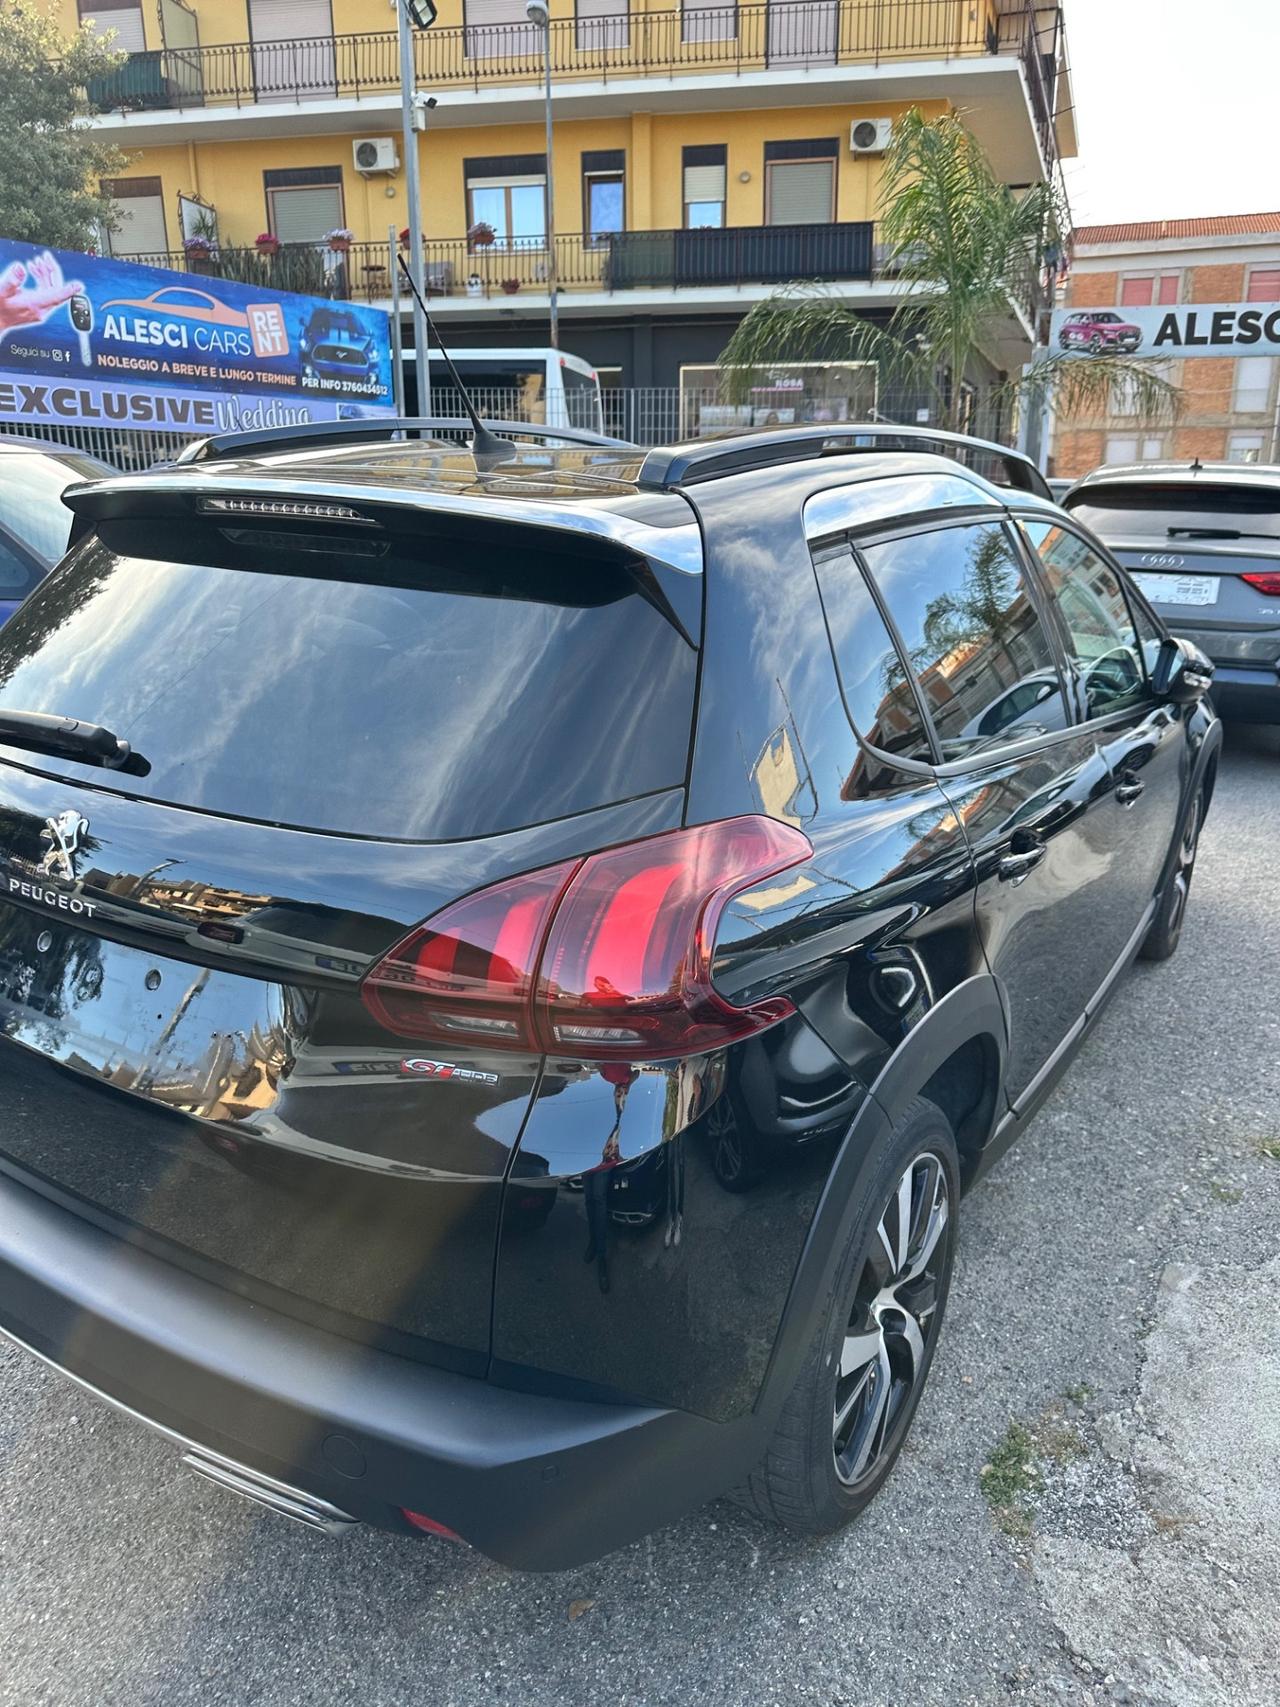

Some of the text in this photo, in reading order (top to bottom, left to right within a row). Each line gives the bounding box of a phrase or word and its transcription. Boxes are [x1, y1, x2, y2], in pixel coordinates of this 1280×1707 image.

[252, 310, 279, 332] RE
[103, 314, 251, 356] ALESCI CARS
[256, 331, 283, 353] NT
[97, 354, 297, 386] NOLEGGIO A BREVE E LUNGO TERMINE
[302, 376, 319, 389] PER
[320, 378, 341, 391] INFO
[0, 384, 215, 425] EXCLUSIVE
[9, 878, 98, 918] PEUGEOT
[402, 1058, 456, 1076] GT
